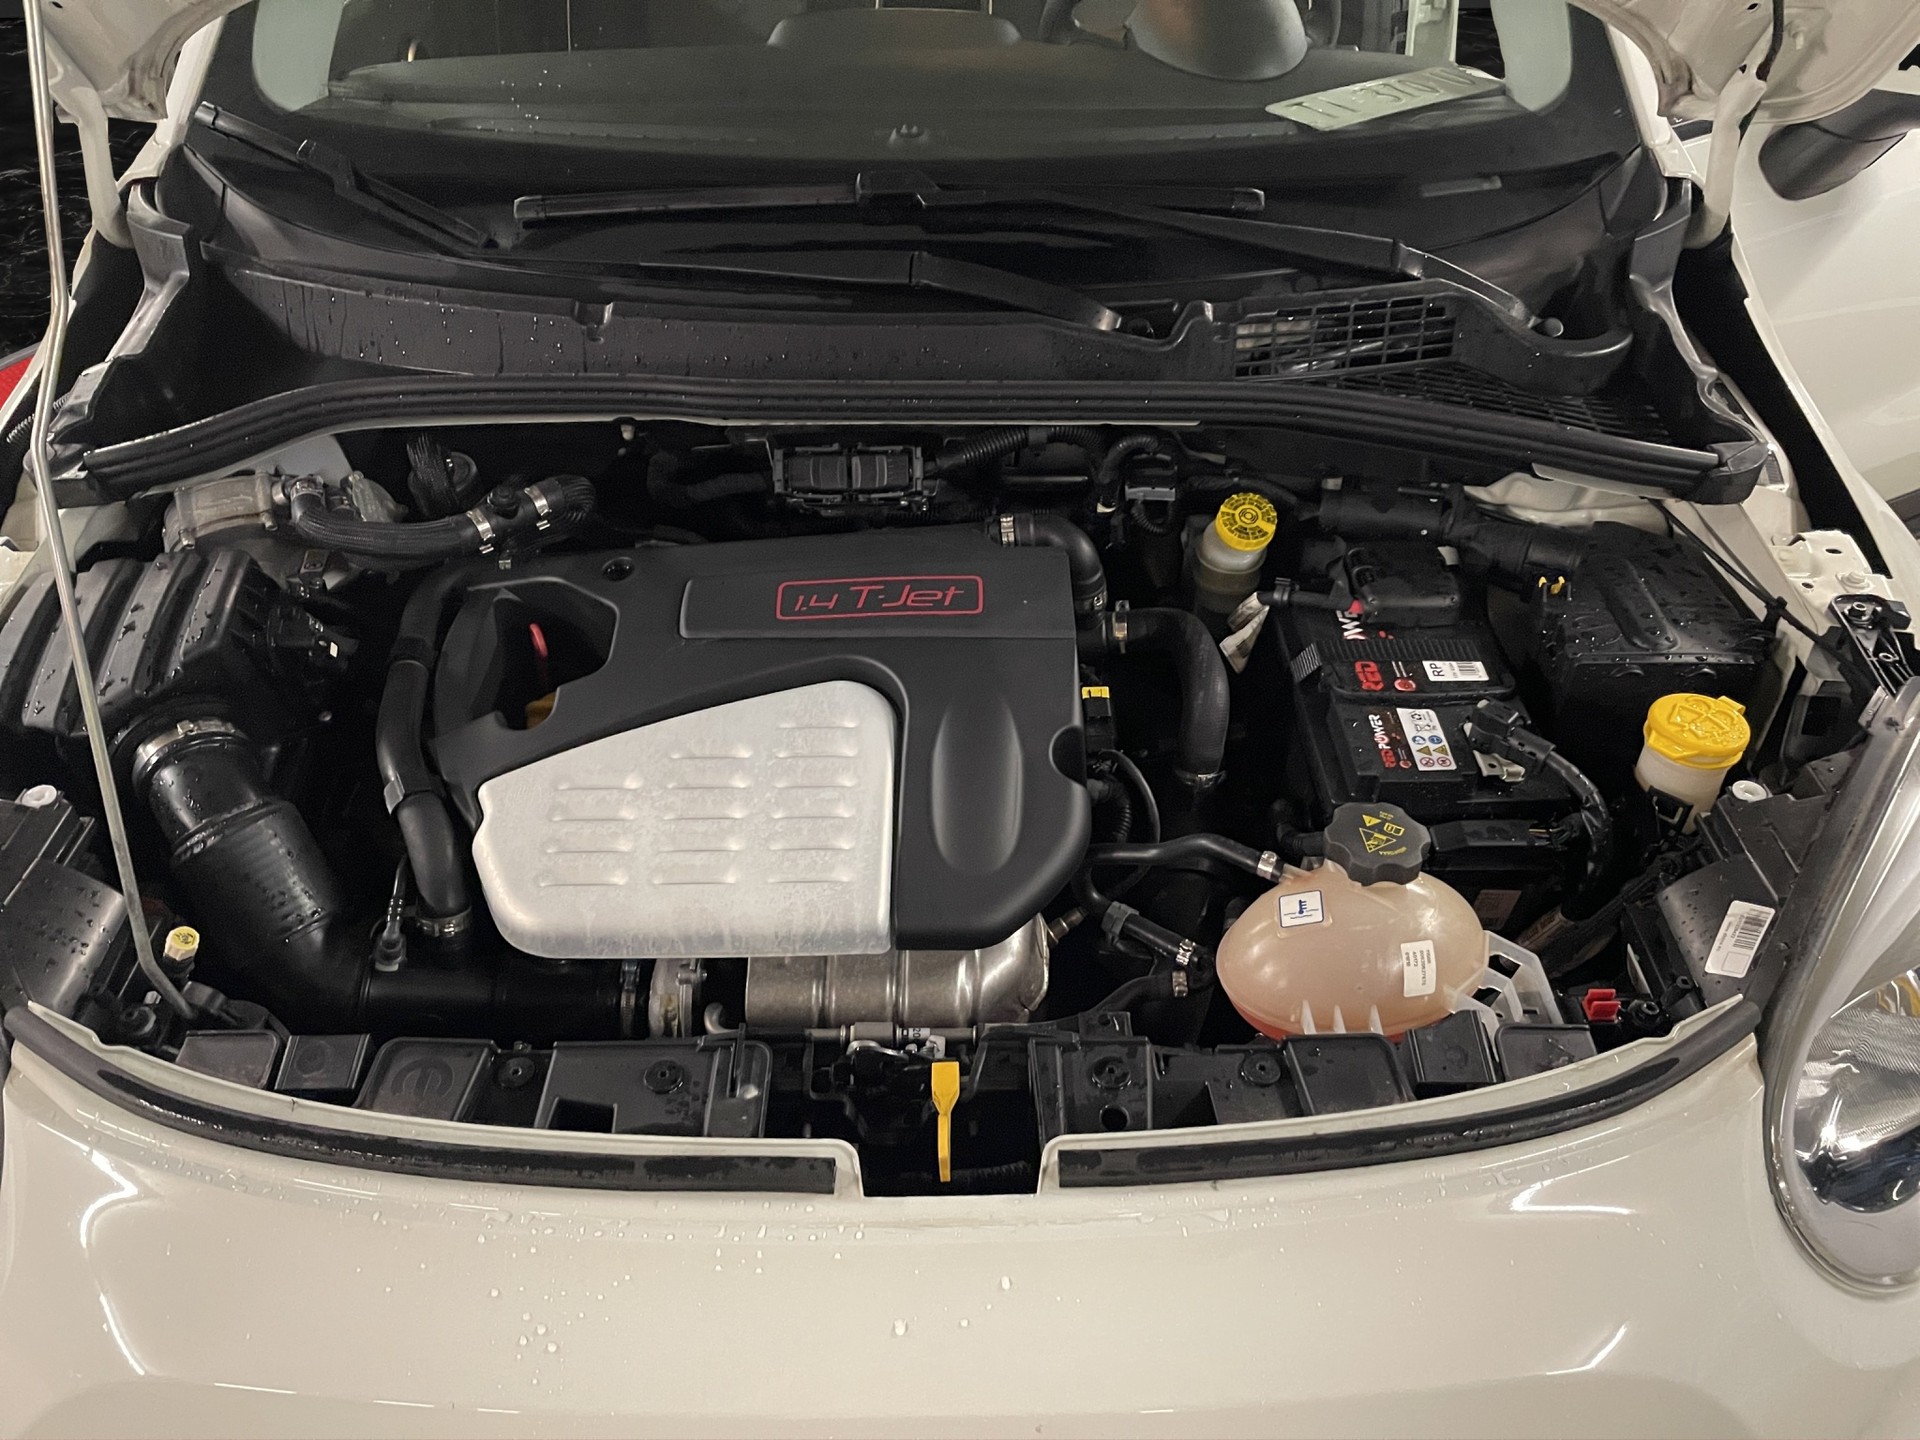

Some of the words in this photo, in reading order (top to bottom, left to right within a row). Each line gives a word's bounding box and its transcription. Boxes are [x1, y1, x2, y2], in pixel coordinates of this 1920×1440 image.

[795, 593, 838, 611] 1.4
[1354, 661, 1384, 691] RED
[1429, 663, 1445, 677] RP
